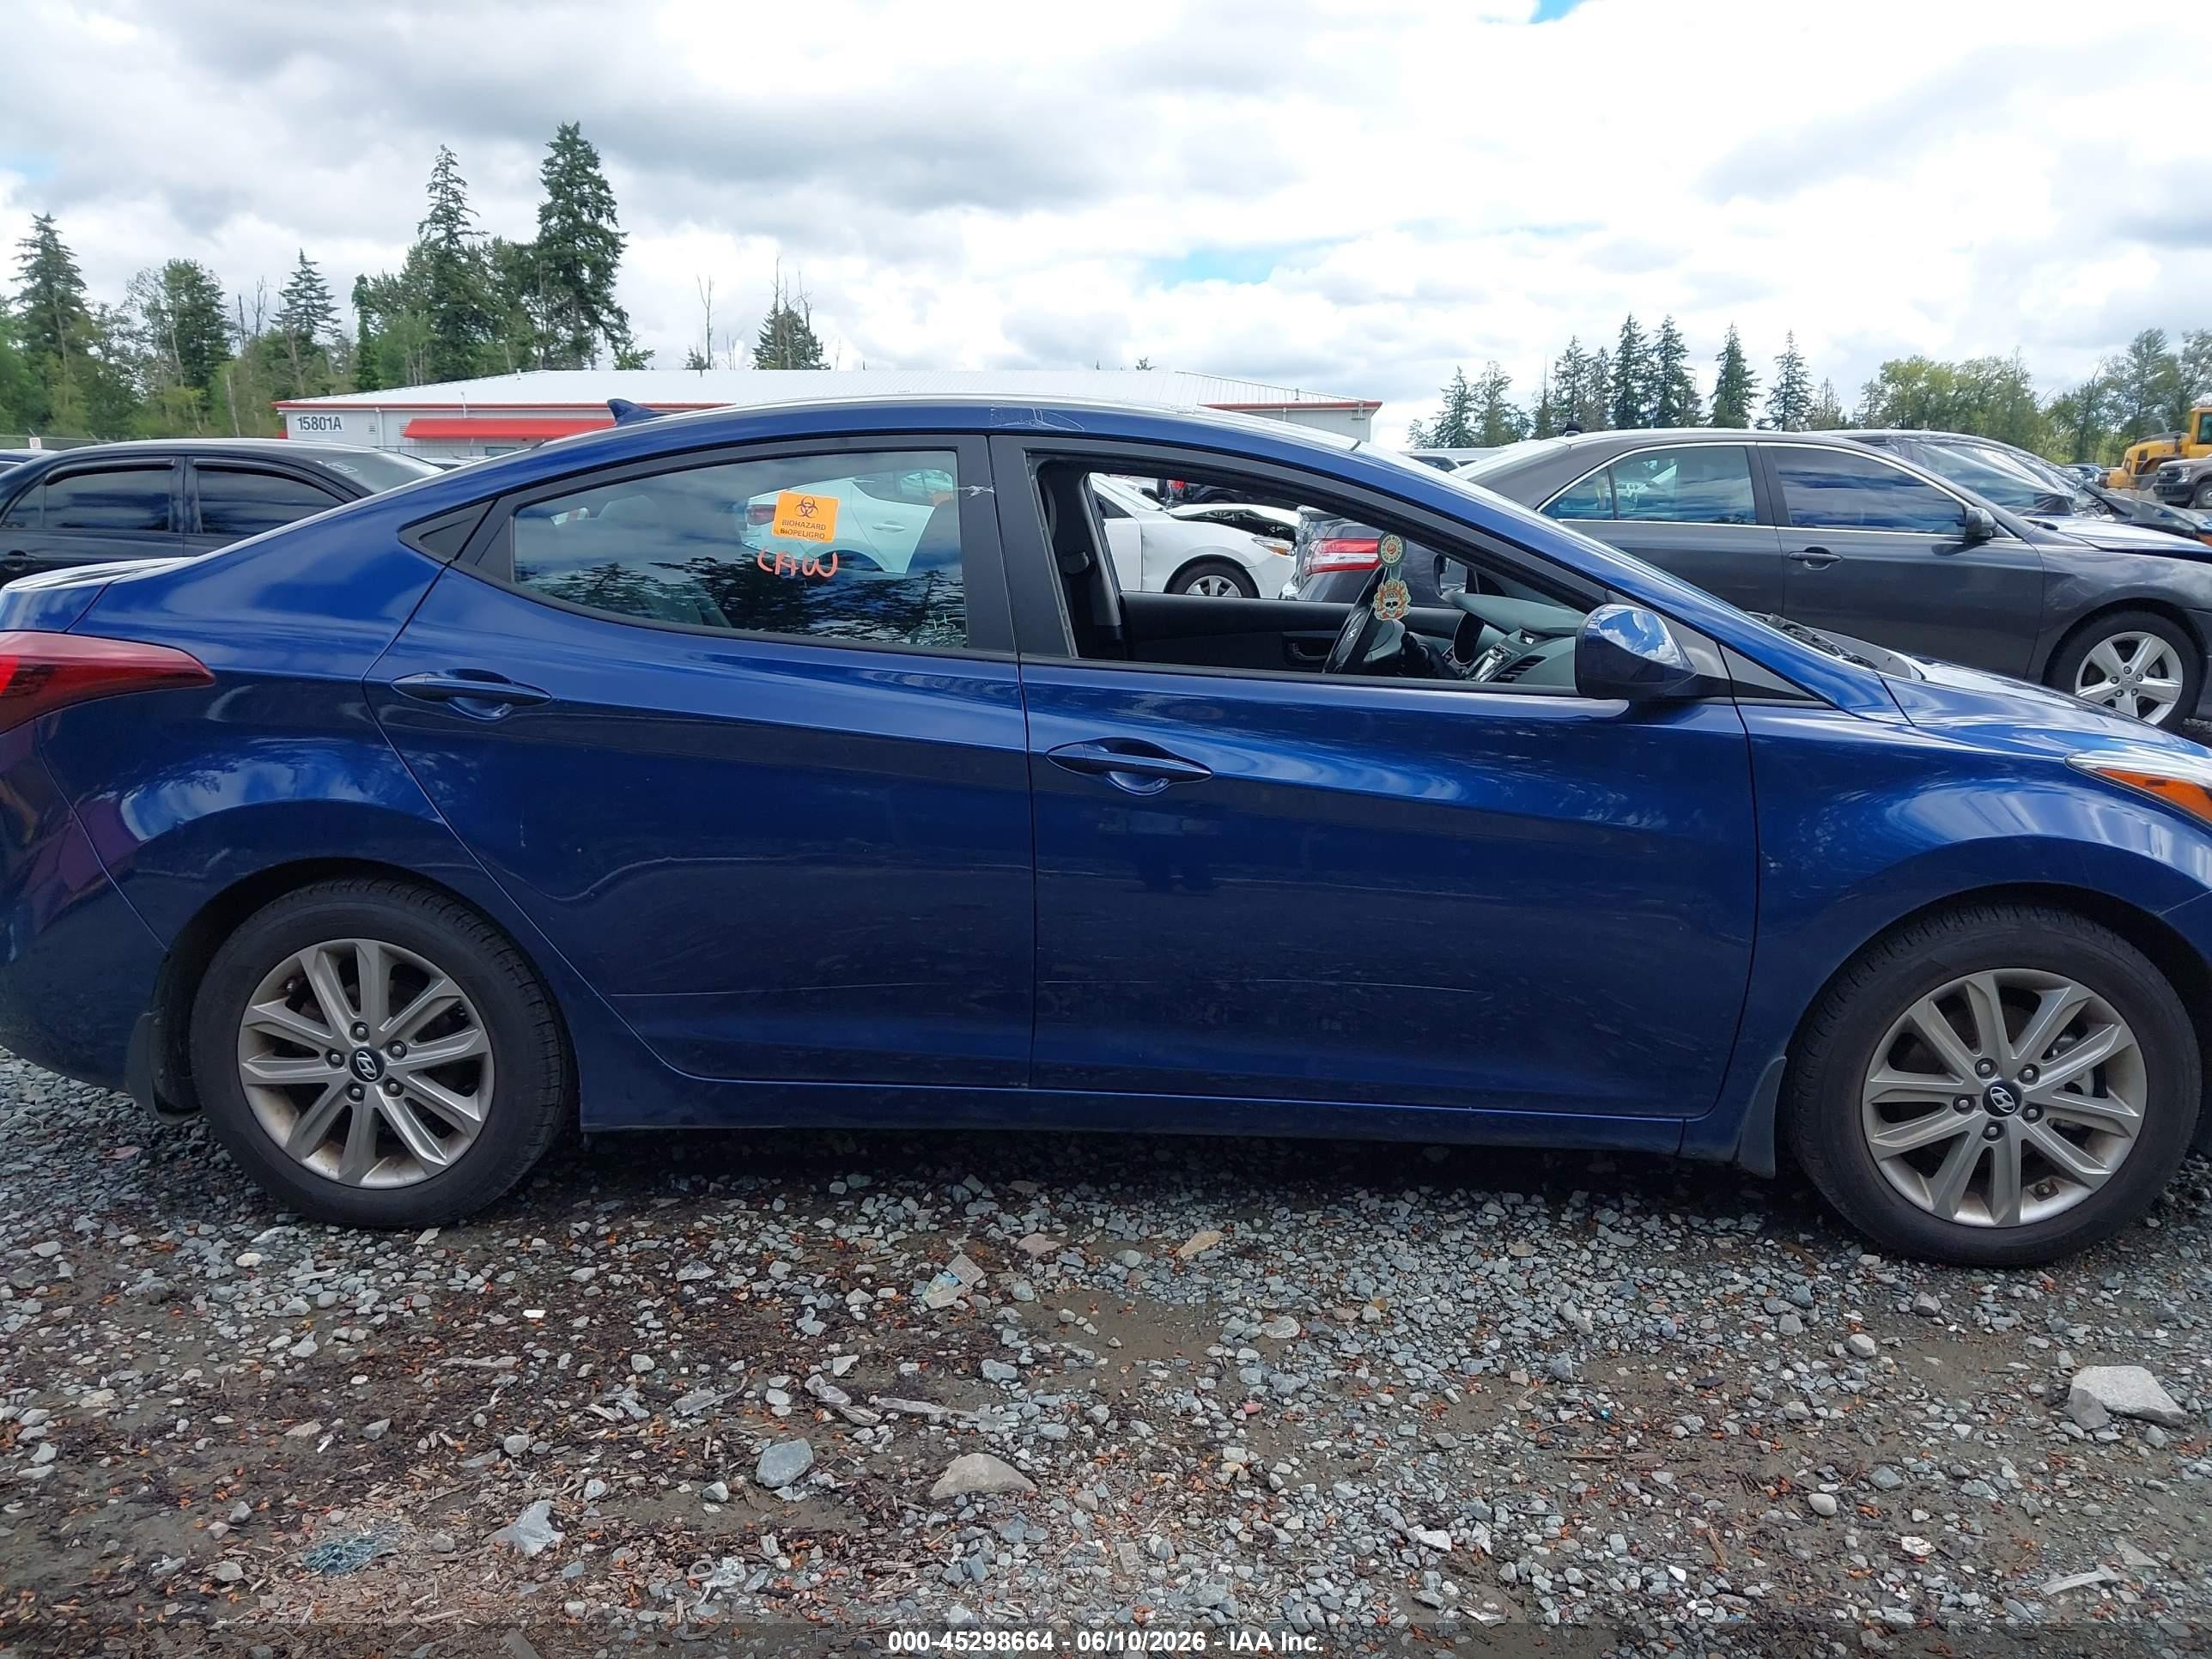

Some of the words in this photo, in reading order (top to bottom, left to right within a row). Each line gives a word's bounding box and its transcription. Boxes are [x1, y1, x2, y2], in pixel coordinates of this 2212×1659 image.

[297, 416, 342, 430] 15801A
[781, 520, 826, 531] BIOHAZARD
[780, 528, 825, 539] BIOPELIGRO
